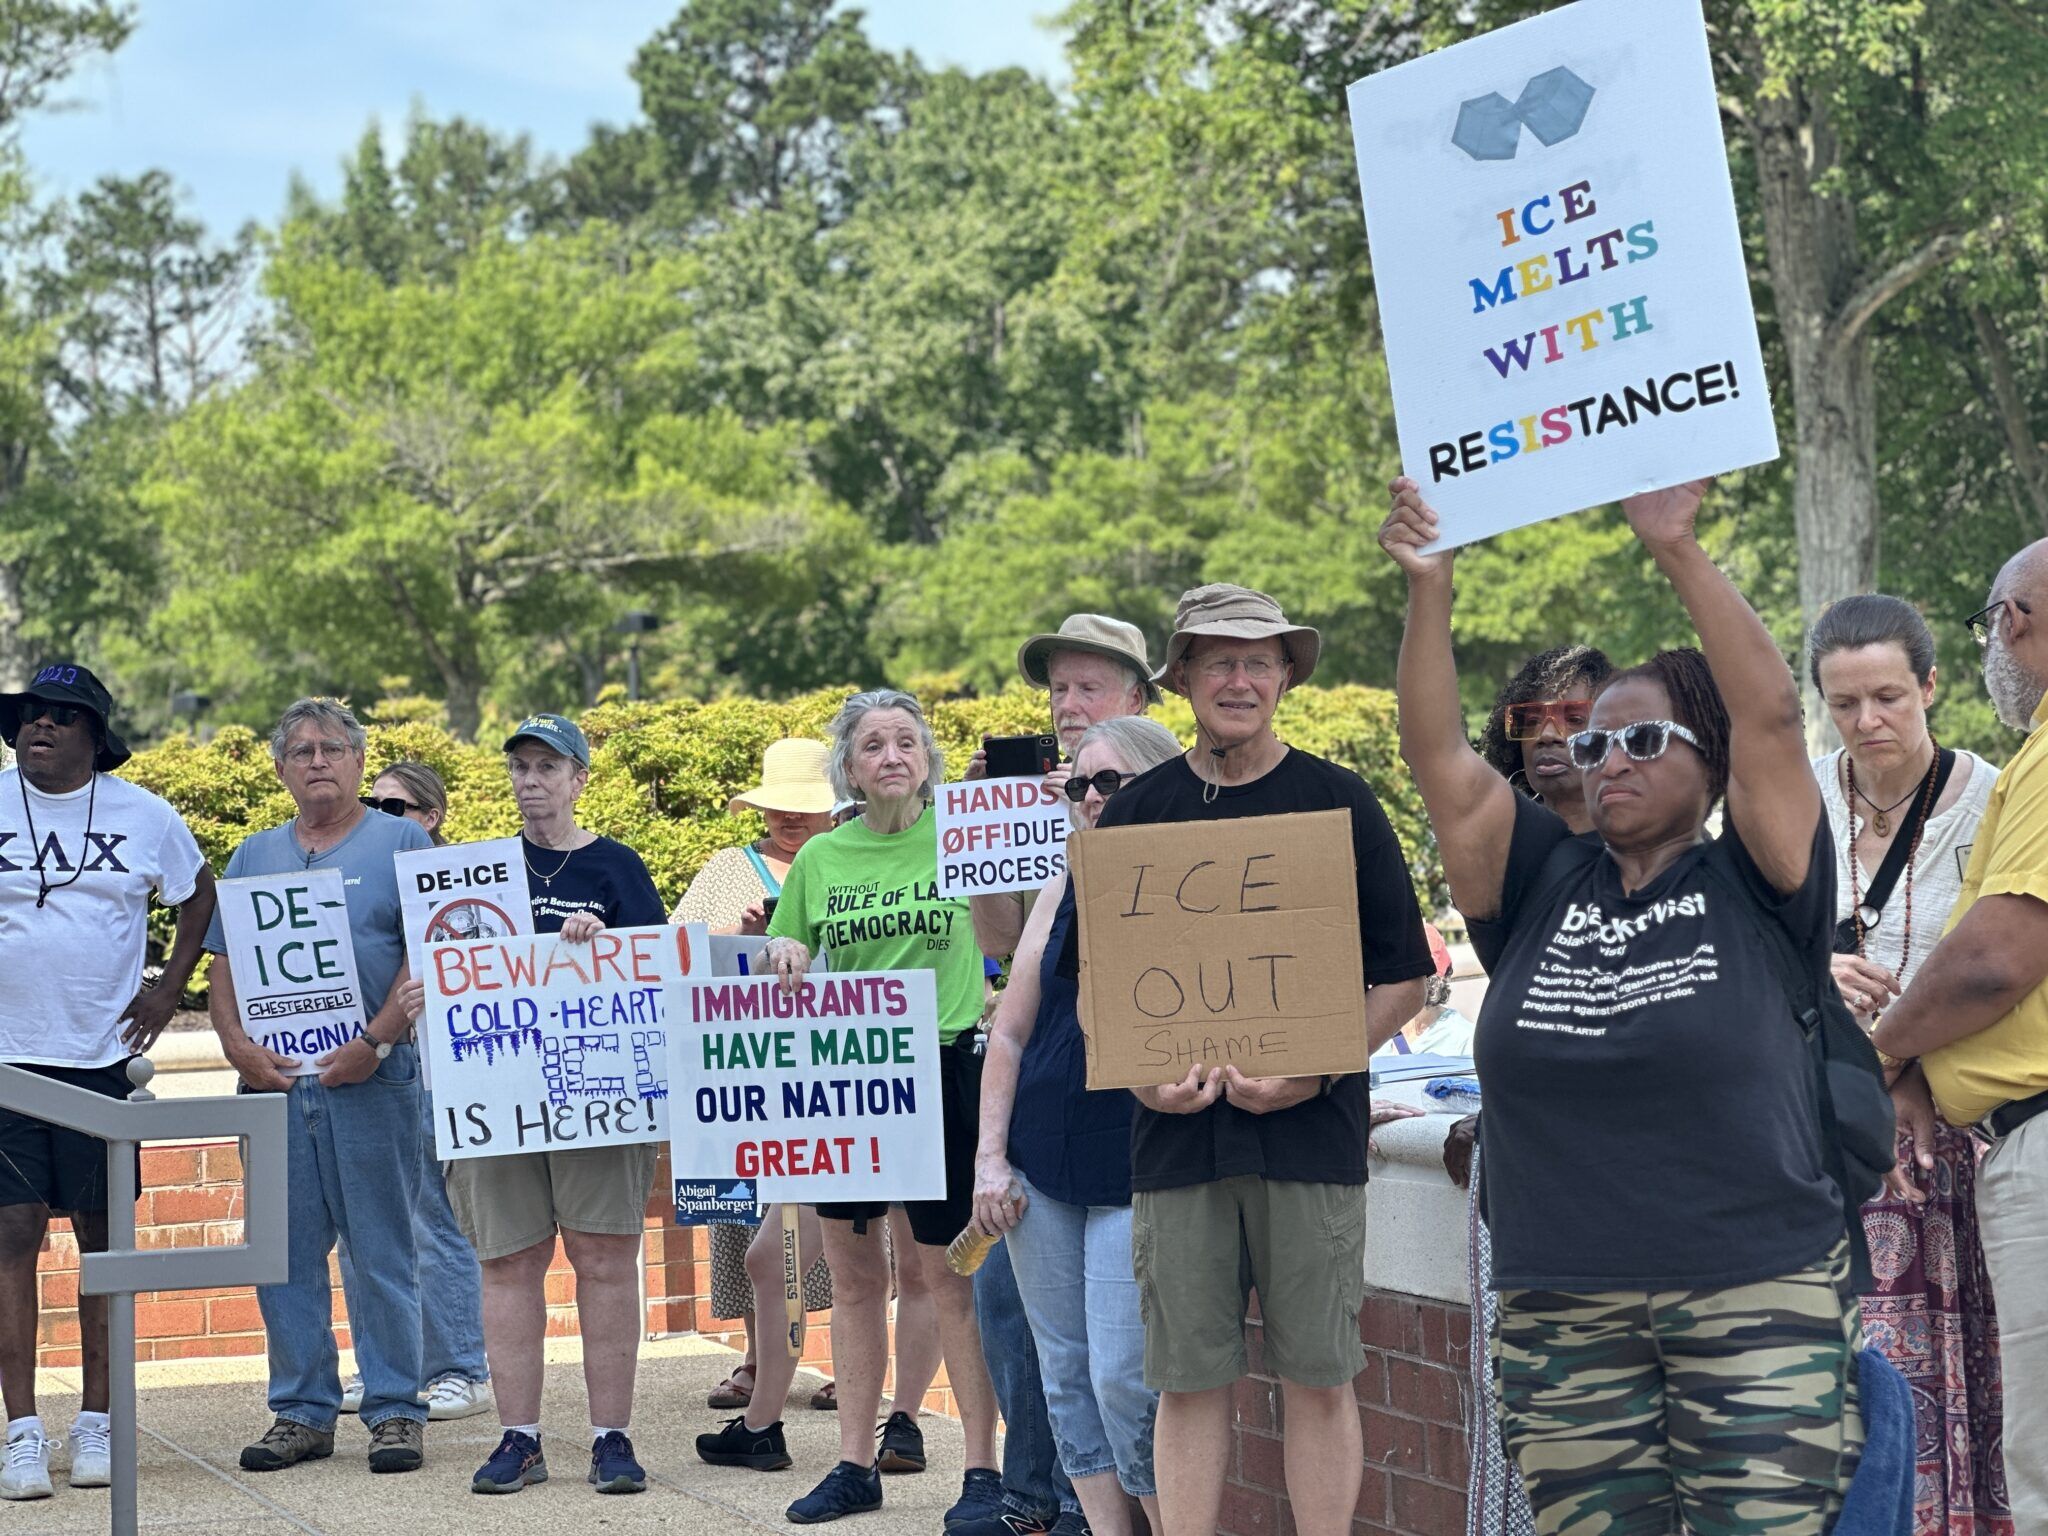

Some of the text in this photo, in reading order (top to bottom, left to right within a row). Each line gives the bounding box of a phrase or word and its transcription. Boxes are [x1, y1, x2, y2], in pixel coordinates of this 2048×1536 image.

[1497, 180, 1596, 247] ICE
[1469, 220, 1658, 313] MELTS
[1483, 295, 1653, 378] WITH
[1429, 361, 1740, 482] RESISTANCE!
[947, 782, 1059, 815] HANDS
[416, 862, 508, 893] DE-ICE
[828, 882, 880, 895] WITHOUT
[945, 854, 1066, 888] PROCESS
[1121, 854, 1280, 917] ICE
[251, 887, 345, 931] DE-
[550, 897, 587, 908] Becomes
[826, 881, 956, 918] RULE OF LA
[827, 910, 954, 949] DEMOCRACY
[927, 939, 950, 950] DIES
[255, 940, 344, 986] ICE
[1545, 946, 1571, 960] noun
[1551, 964, 1571, 974] One
[1675, 956, 1691, 965] for
[1134, 955, 1296, 1018] OUT
[1574, 978, 1588, 987] by
[1658, 972, 1676, 981] the
[248, 993, 353, 1016] CHESTERFIELD
[692, 978, 908, 1022] IMMIGRANTS
[1523, 1001, 1571, 1012] prejudice
[1573, 1005, 1609, 1016] against
[1649, 992, 1662, 1001] of
[1664, 988, 1695, 999] color.
[702, 1027, 915, 1070] HAVE MADE
[1137, 1030, 1288, 1066] SHAME
[696, 1077, 916, 1123] OUR NATION
[445, 1097, 658, 1149] IS HERE!
[735, 1137, 855, 1177] GREAT
[677, 1184, 716, 1199] Abigail
[677, 1197, 755, 1214] Spanberger
[783, 1229, 793, 1249] DAY
[785, 1252, 794, 1284] EVERY
